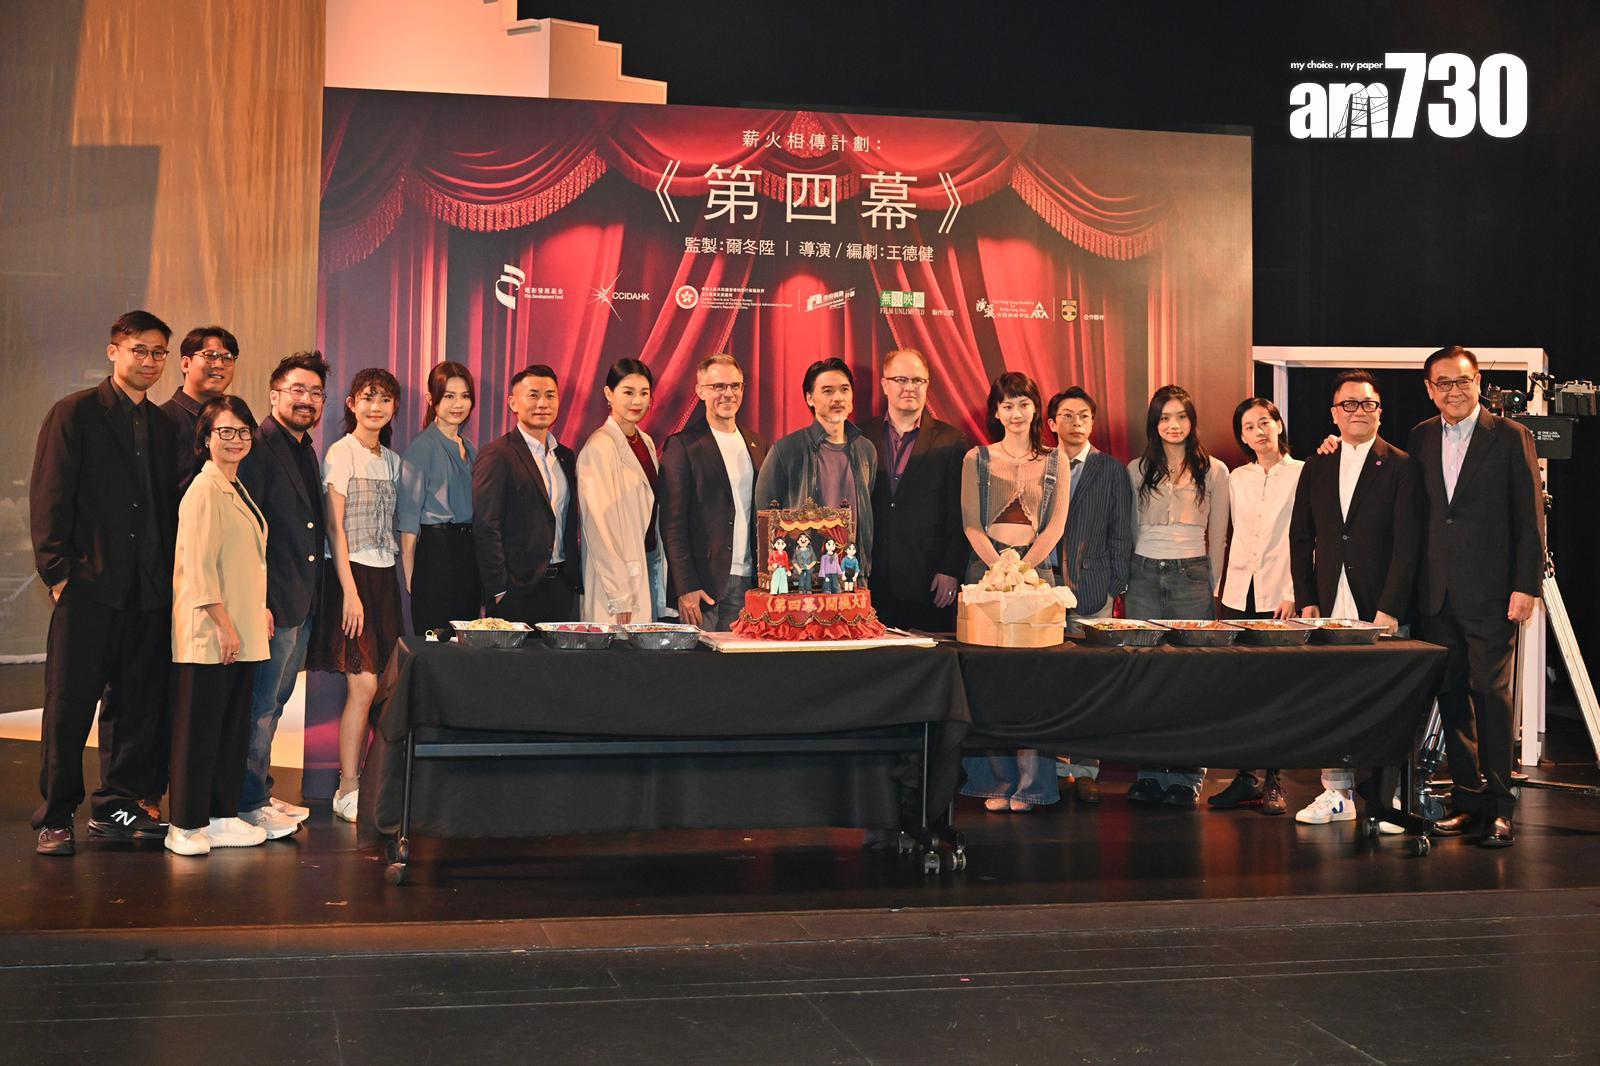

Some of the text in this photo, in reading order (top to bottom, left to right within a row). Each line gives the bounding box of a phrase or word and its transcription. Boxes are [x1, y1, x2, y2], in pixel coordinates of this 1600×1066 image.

[656, 160, 962, 233] 《第四幕》
[612, 292, 650, 301] CCIDAHK
[895, 308, 925, 316] UNLIMITED
